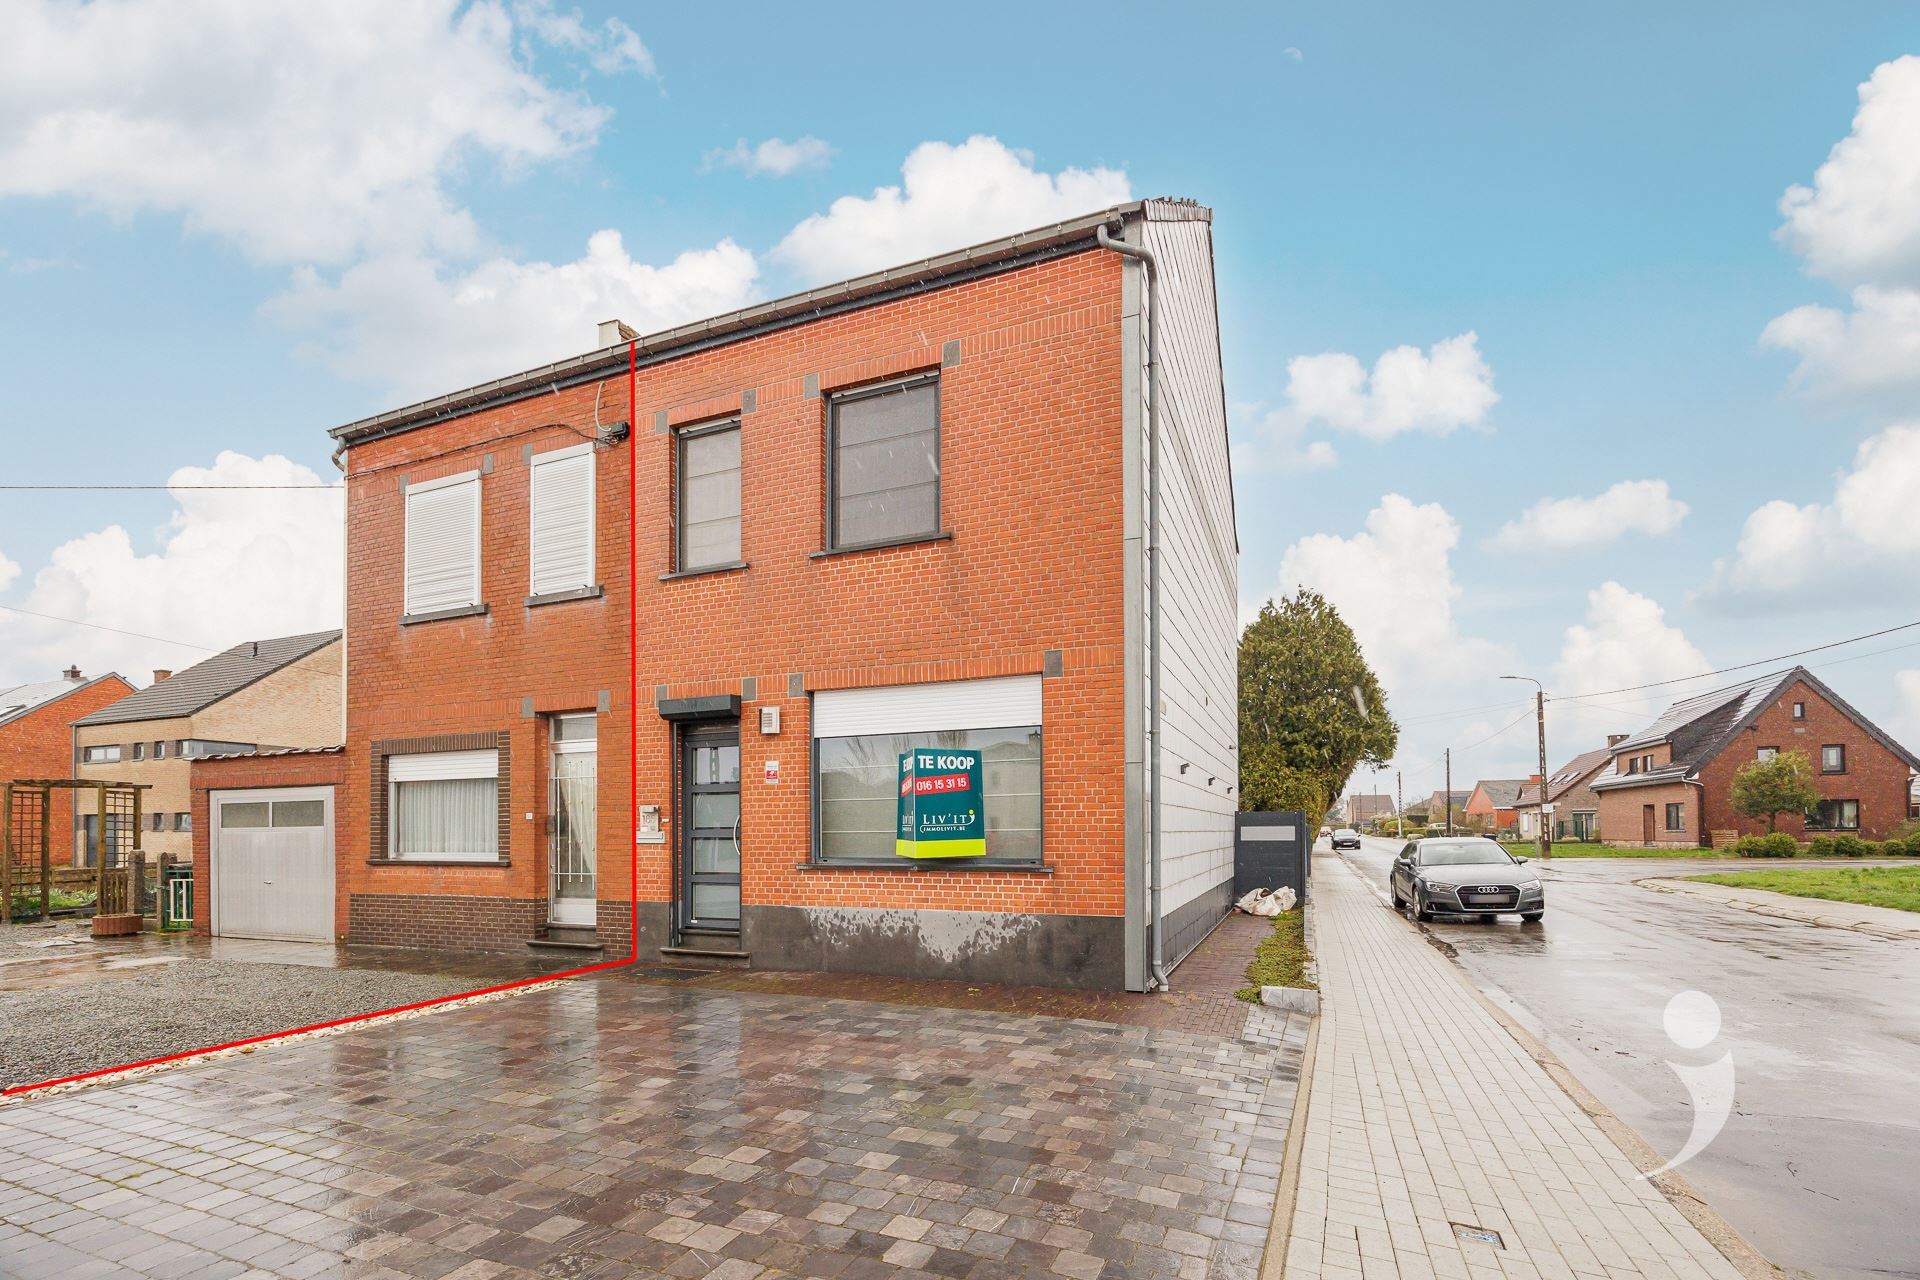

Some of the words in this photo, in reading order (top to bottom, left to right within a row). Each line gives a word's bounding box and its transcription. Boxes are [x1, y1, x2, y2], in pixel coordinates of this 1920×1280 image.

[918, 755, 934, 769] TE
[937, 755, 975, 770] KOOP
[916, 780, 932, 791] 016
[934, 779, 944, 790] 15
[946, 778, 955, 789] 31
[957, 777, 967, 788] 15
